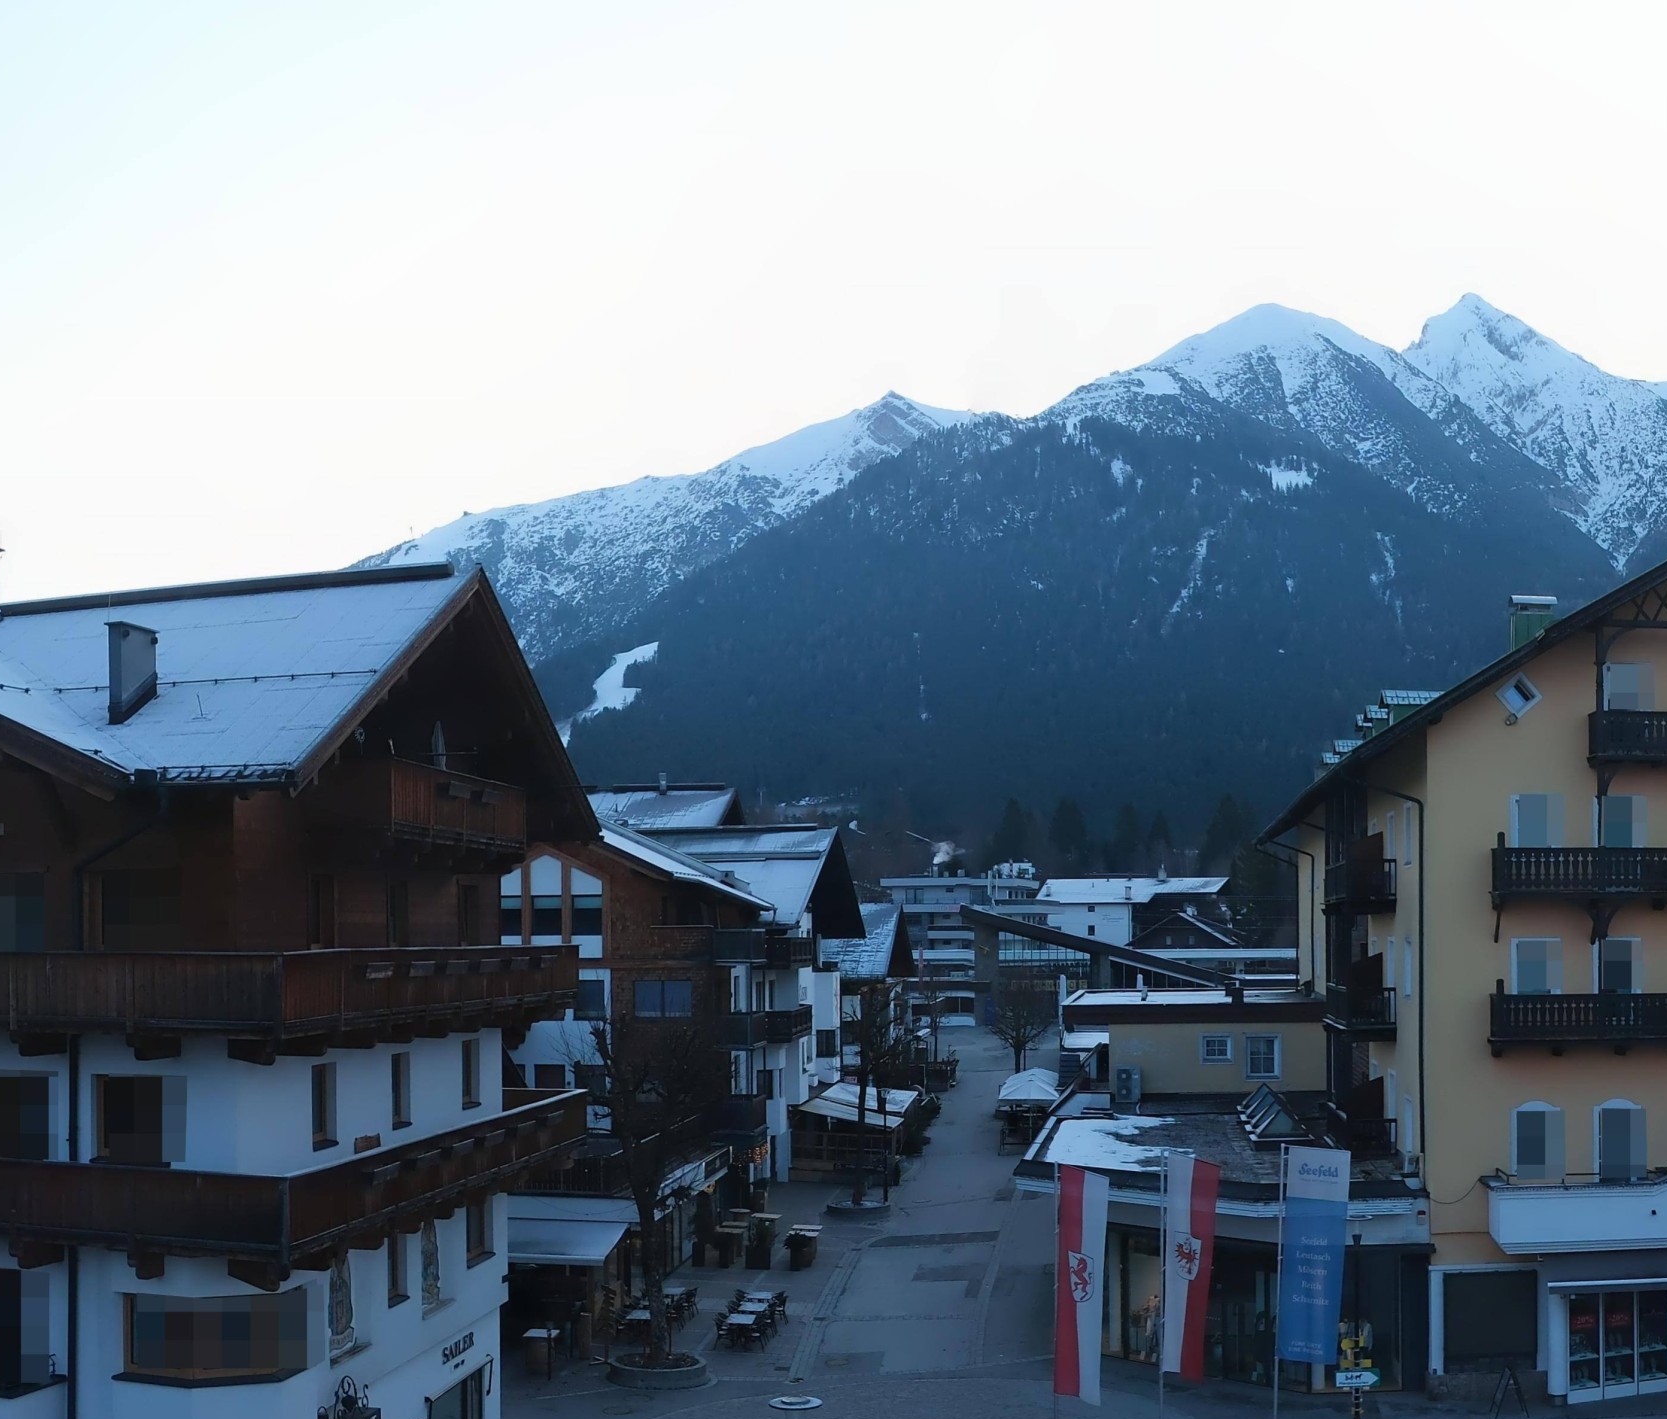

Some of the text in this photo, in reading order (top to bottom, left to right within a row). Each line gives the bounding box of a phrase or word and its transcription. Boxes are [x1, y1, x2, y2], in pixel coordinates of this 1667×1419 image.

[1298, 1162, 1339, 1178] Seefeld
[1300, 1236, 1328, 1246] Seefeld
[1296, 1250, 1331, 1261] Leutasch
[442, 1331, 475, 1365] SAILER
